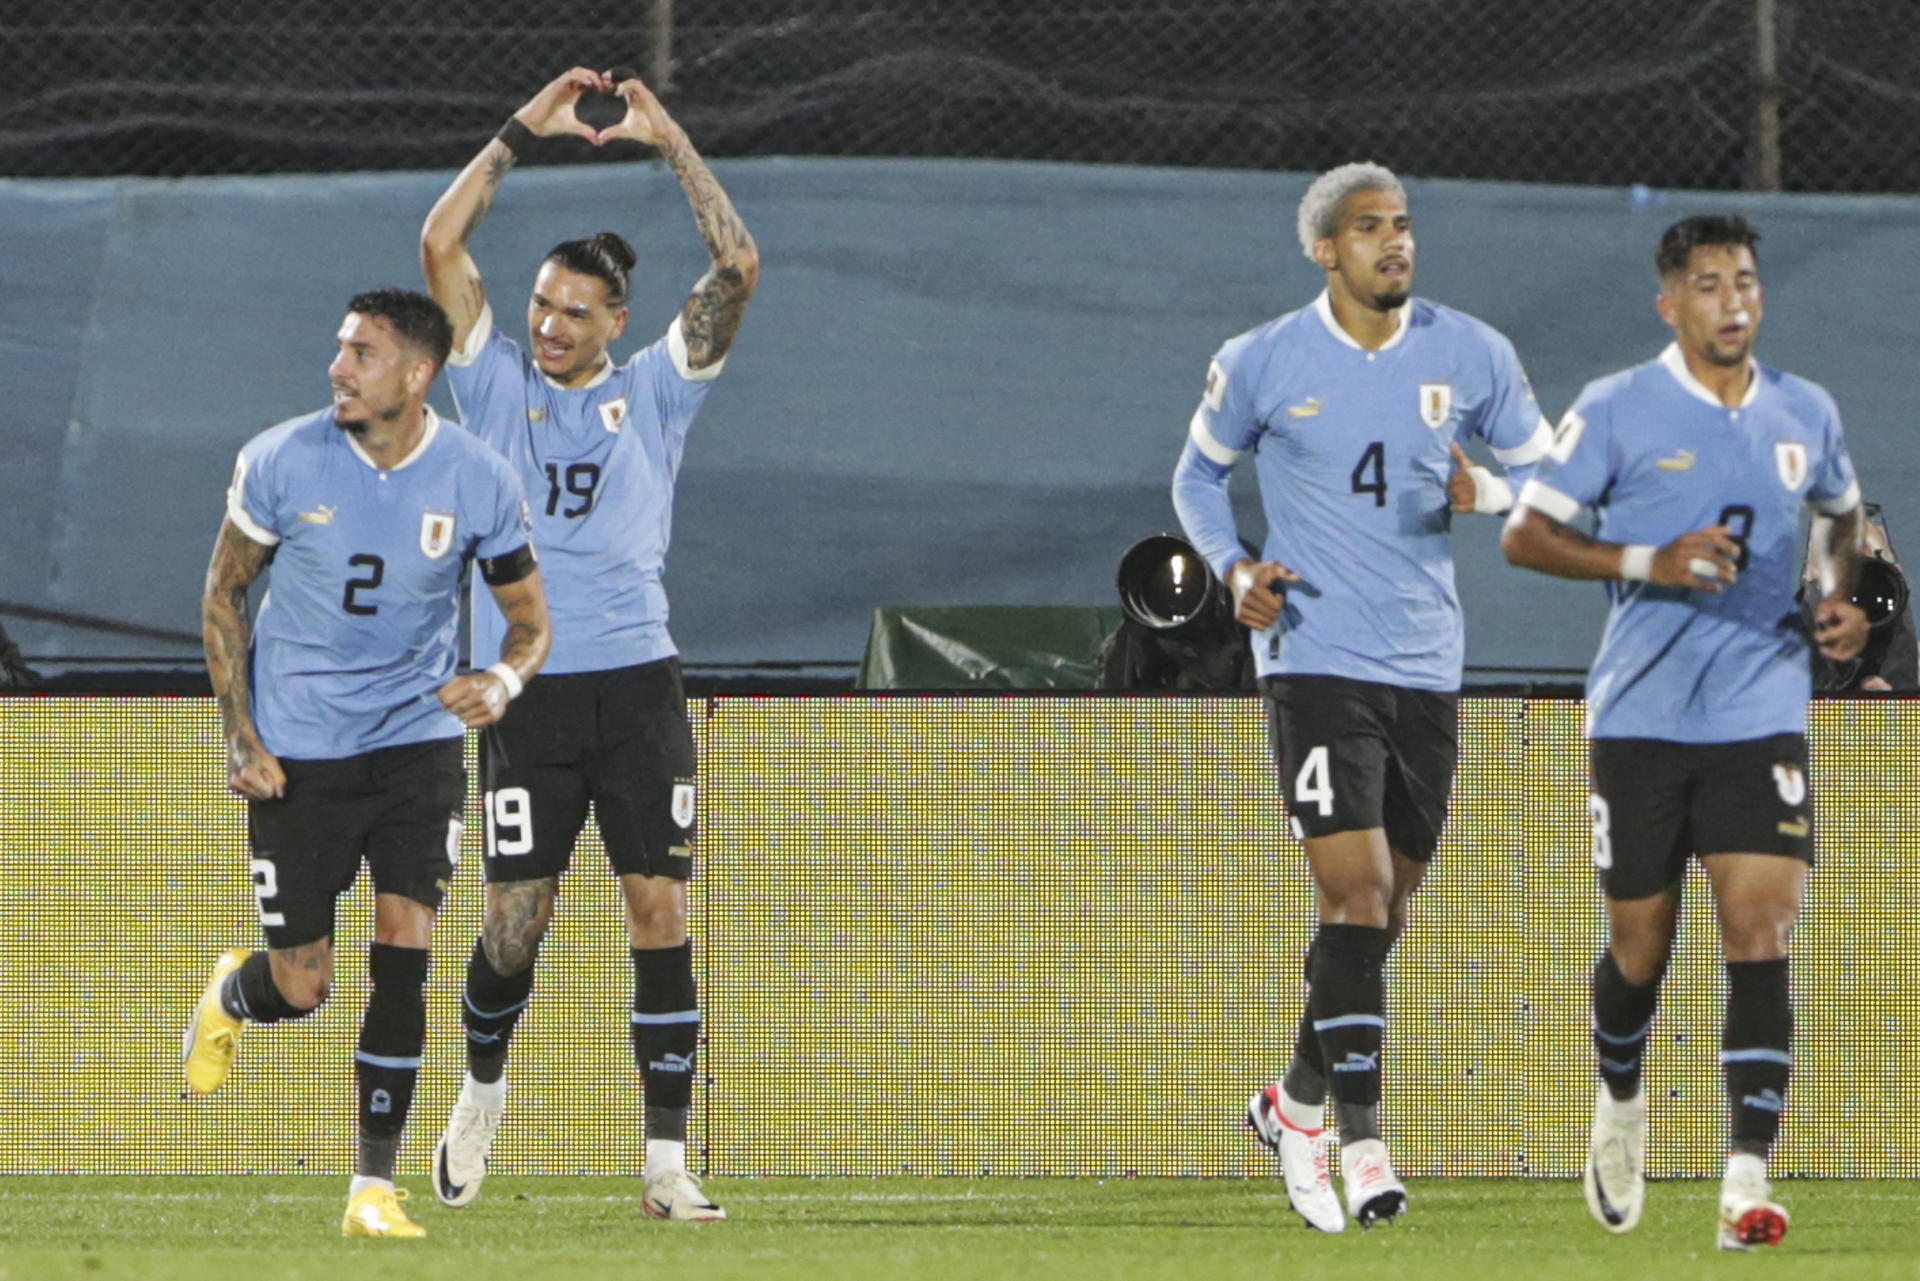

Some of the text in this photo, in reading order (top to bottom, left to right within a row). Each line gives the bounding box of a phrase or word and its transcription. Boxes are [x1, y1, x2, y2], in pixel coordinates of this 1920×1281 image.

[545, 462, 601, 518] 19
[1351, 441, 1387, 507] 4
[342, 553, 385, 616] 2
[1295, 746, 1334, 816] 4
[484, 787, 534, 857] 19
[251, 858, 286, 926] 2
